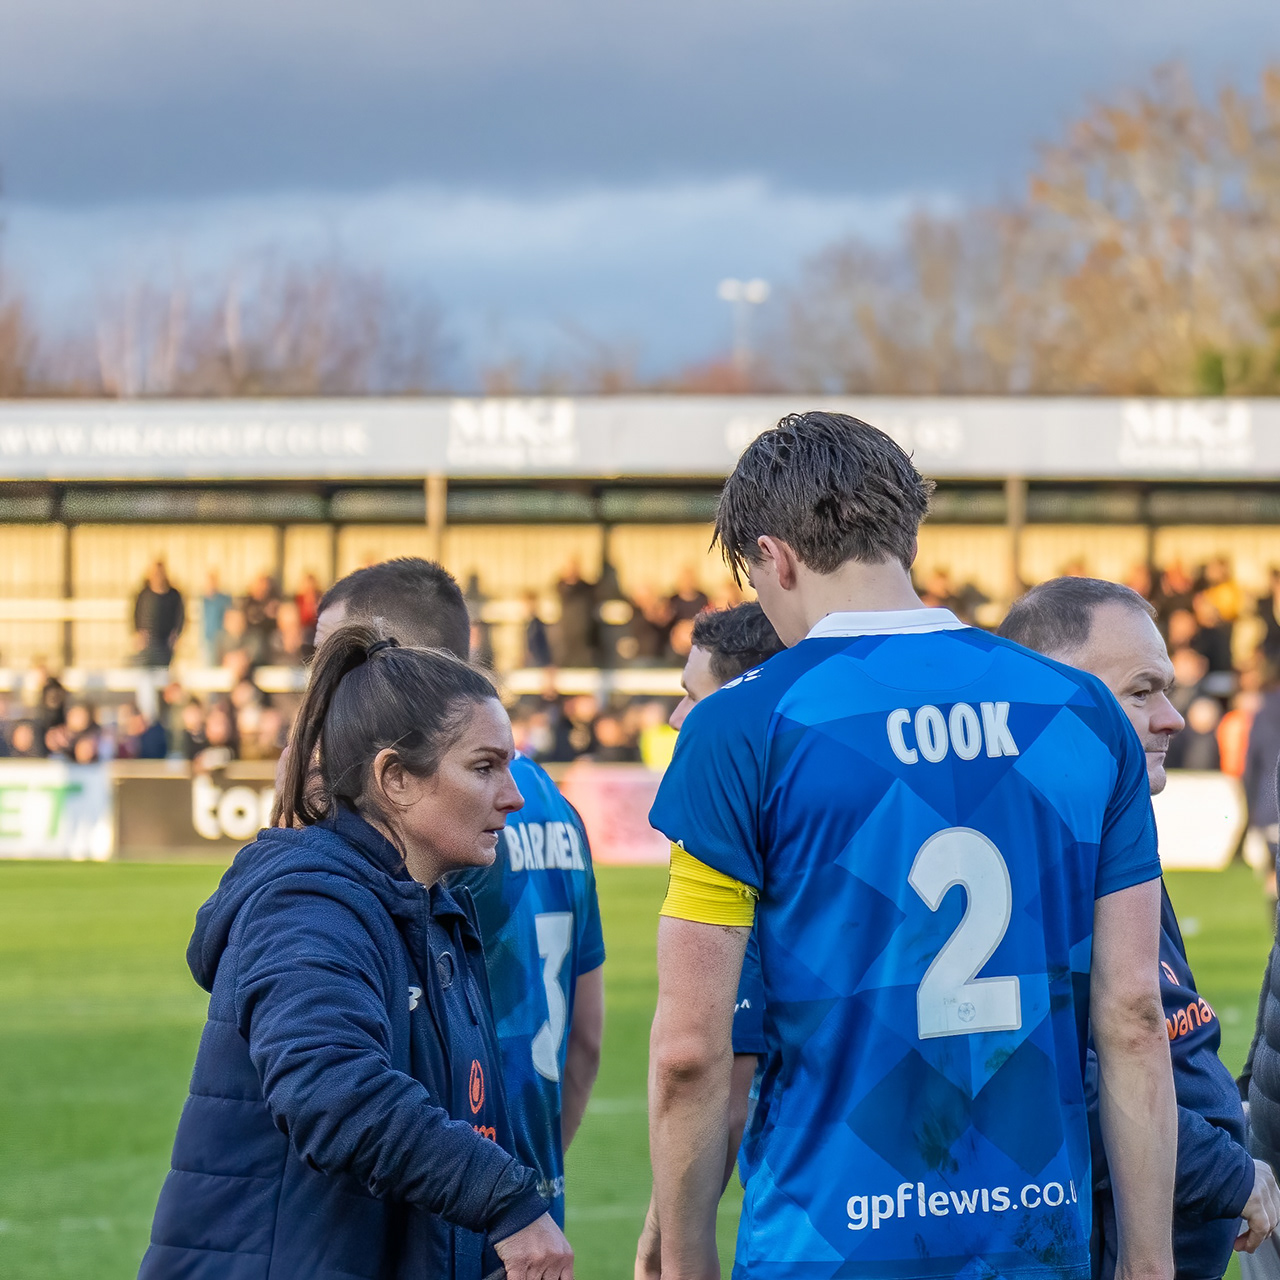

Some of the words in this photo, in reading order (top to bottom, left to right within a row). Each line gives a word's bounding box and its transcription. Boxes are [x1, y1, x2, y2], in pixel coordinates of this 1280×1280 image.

[886, 701, 1020, 765] COOK
[531, 911, 575, 1083] 3
[907, 826, 1023, 1040] 2
